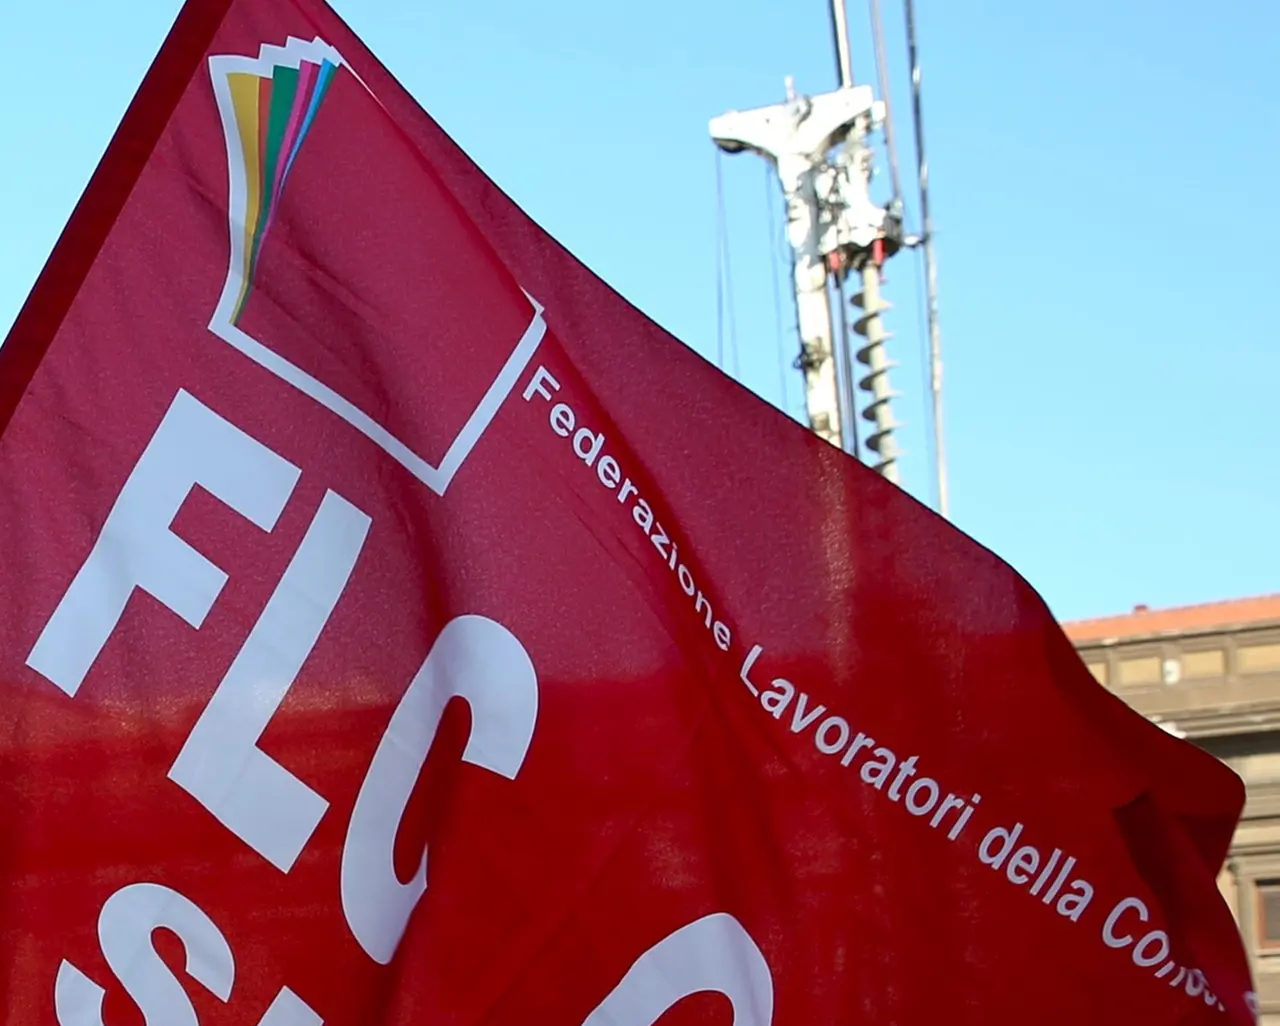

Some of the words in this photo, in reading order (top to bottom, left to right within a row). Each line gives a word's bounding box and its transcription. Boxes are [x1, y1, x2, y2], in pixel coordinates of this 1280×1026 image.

[25, 388, 538, 964] FLC
[522, 365, 733, 652] Federazione
[740, 645, 981, 841] Lavoratori
[978, 823, 1095, 923] della
